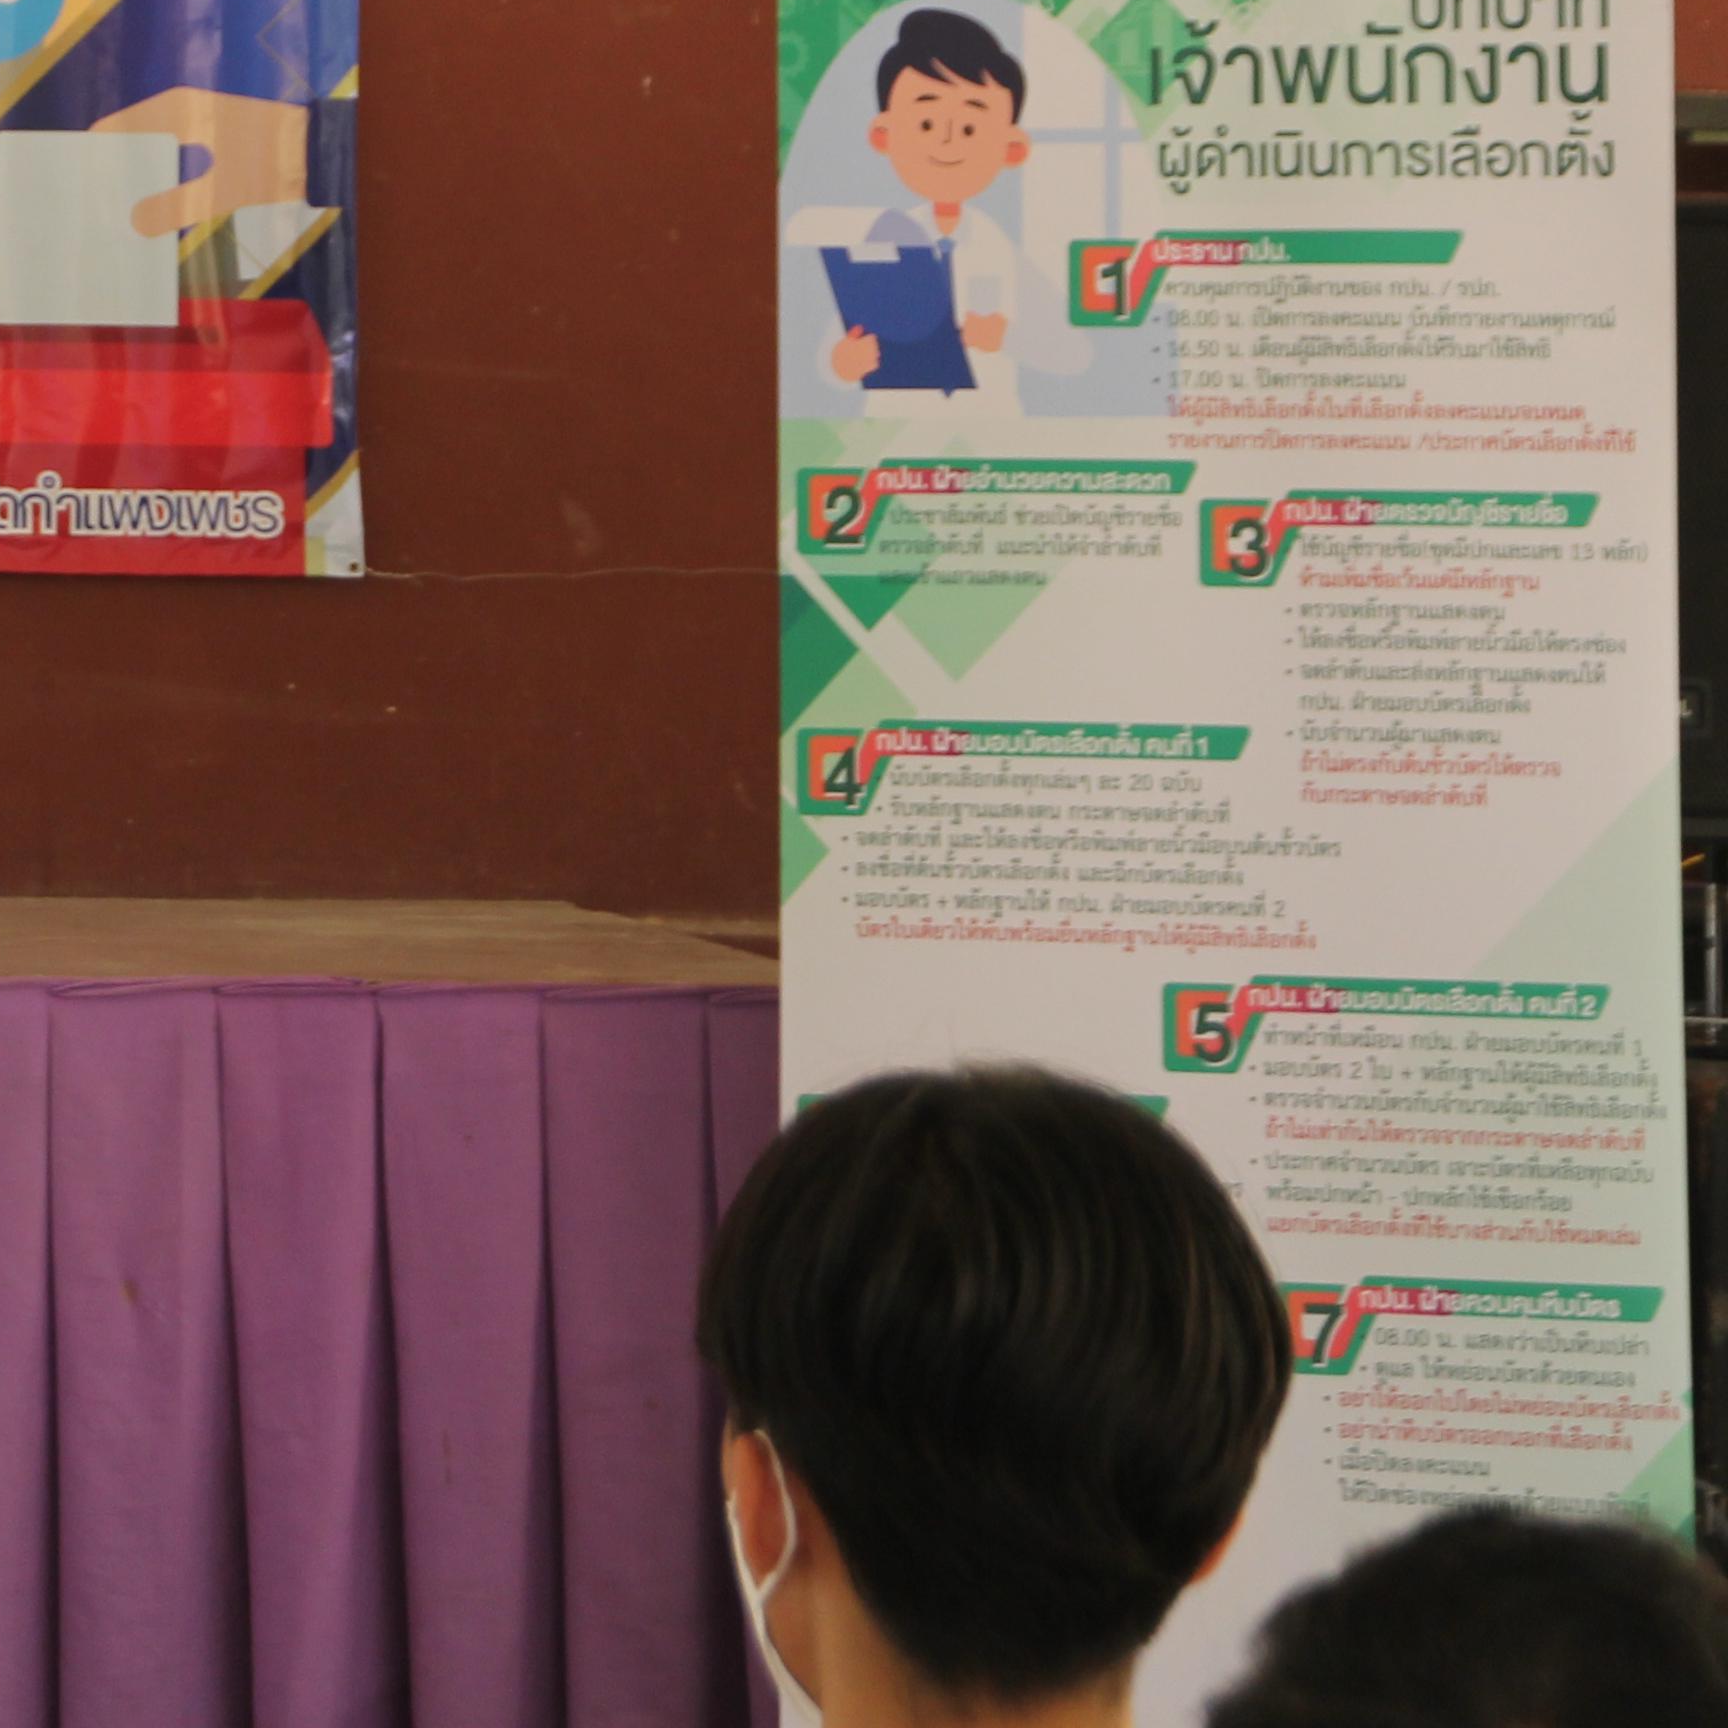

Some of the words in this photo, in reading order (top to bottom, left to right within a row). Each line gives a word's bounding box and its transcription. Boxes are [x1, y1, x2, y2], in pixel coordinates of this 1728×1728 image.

[1146, 19, 1611, 106] เจ้าพนักงาน
[1157, 109, 1616, 197] ผู้ดำเนินการเลือกตั้ง
[1097, 257, 1130, 320] 1
[823, 485, 867, 548] 2
[1227, 515, 1271, 581] 3
[822, 744, 865, 811] 4
[1192, 1001, 1239, 1064] 5
[1302, 1302, 1344, 1369] 7
